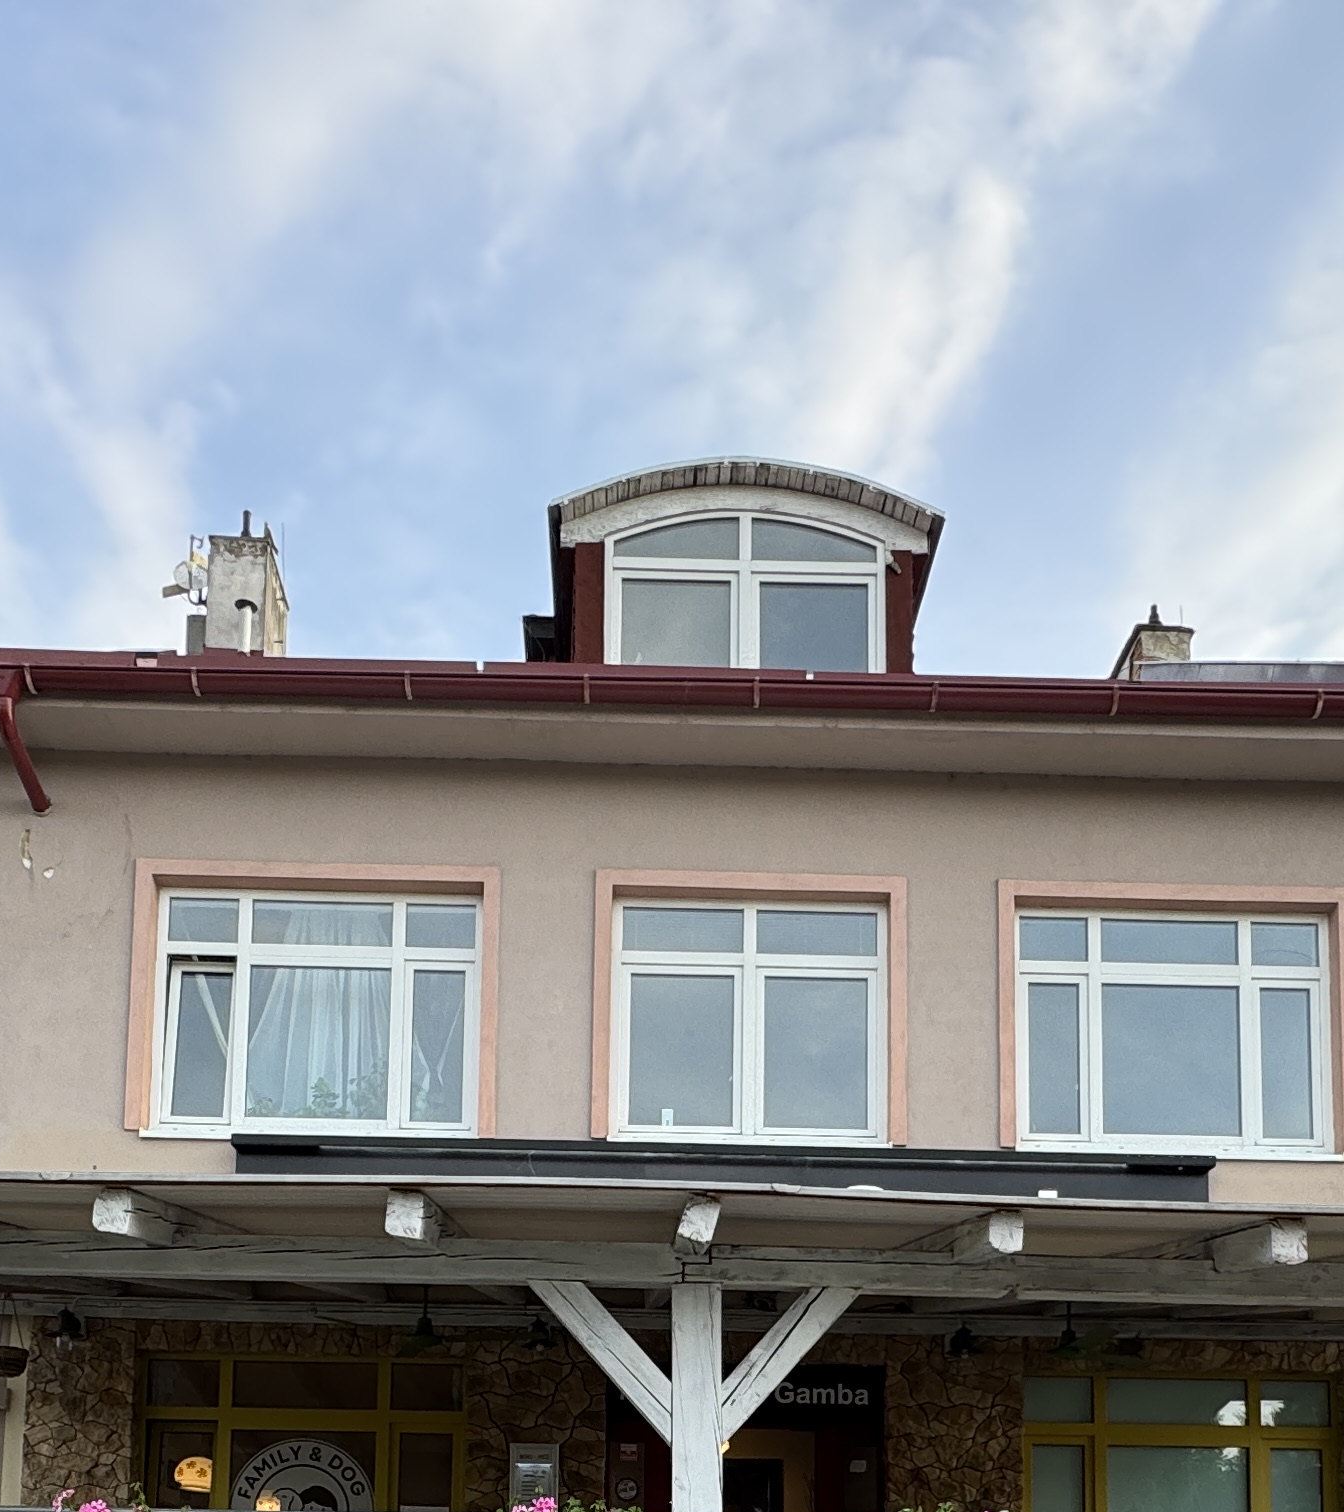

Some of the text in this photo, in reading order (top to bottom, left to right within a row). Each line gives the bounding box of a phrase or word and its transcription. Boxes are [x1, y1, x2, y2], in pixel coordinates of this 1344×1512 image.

[773, 1381, 870, 1406] Gamba
[237, 1444, 366, 1500] FAMILY & DOG
